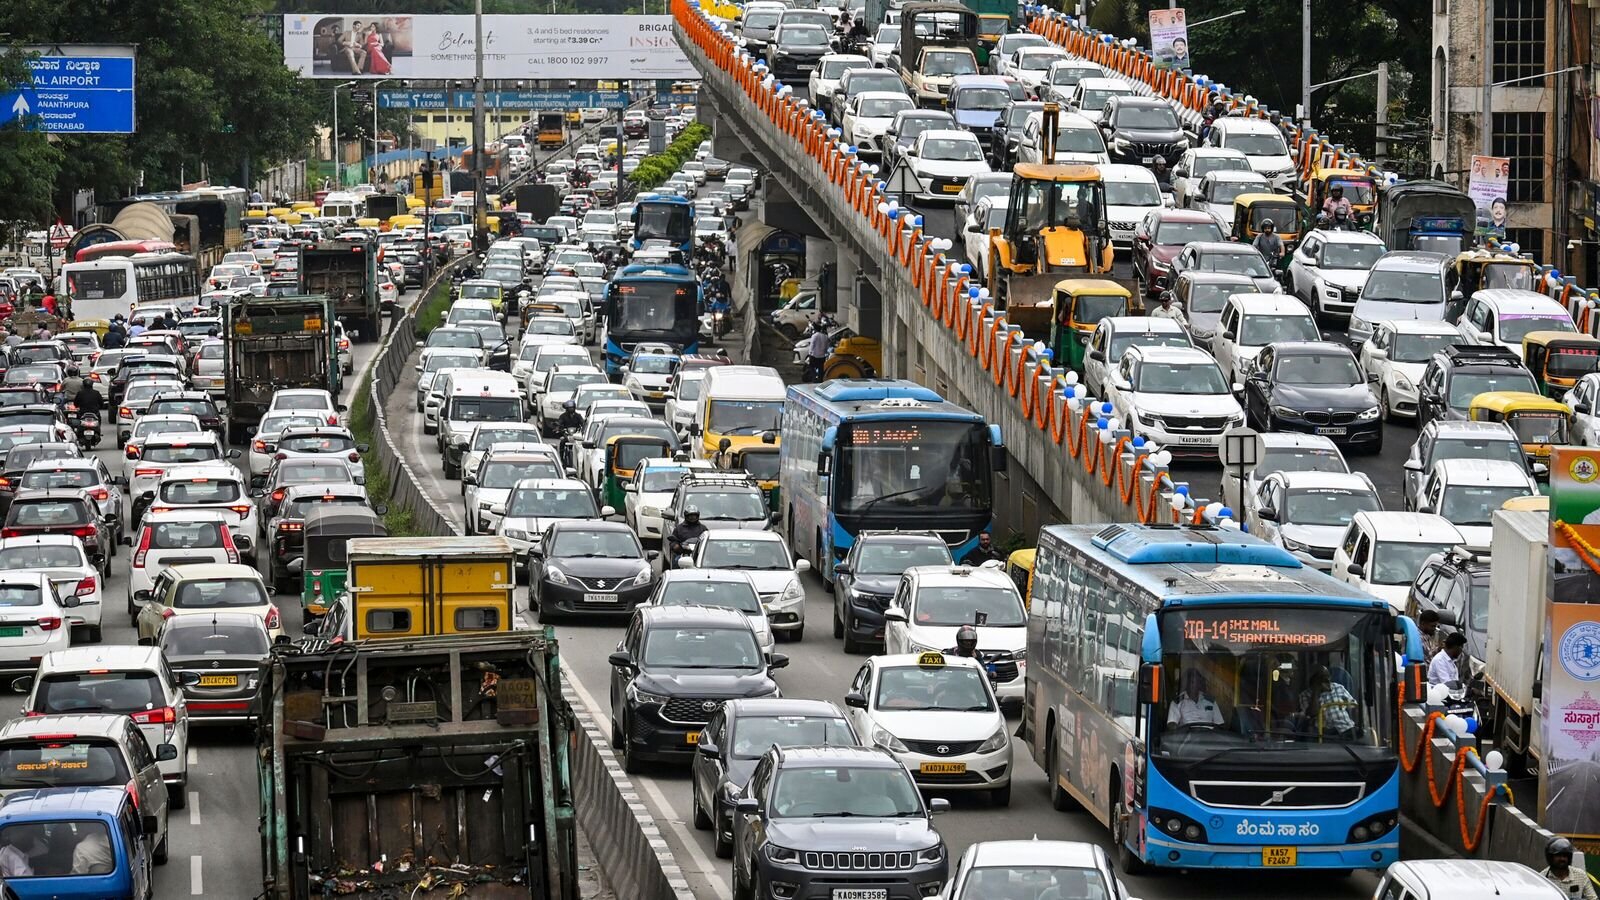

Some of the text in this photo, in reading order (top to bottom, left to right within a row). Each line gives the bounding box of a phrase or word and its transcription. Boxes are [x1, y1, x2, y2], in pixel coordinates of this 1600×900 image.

[31, 76, 100, 86] AL AIRPORT
[1252, 620, 1280, 631] MALL
[1230, 633, 1326, 644] SHANTHINAGAR
